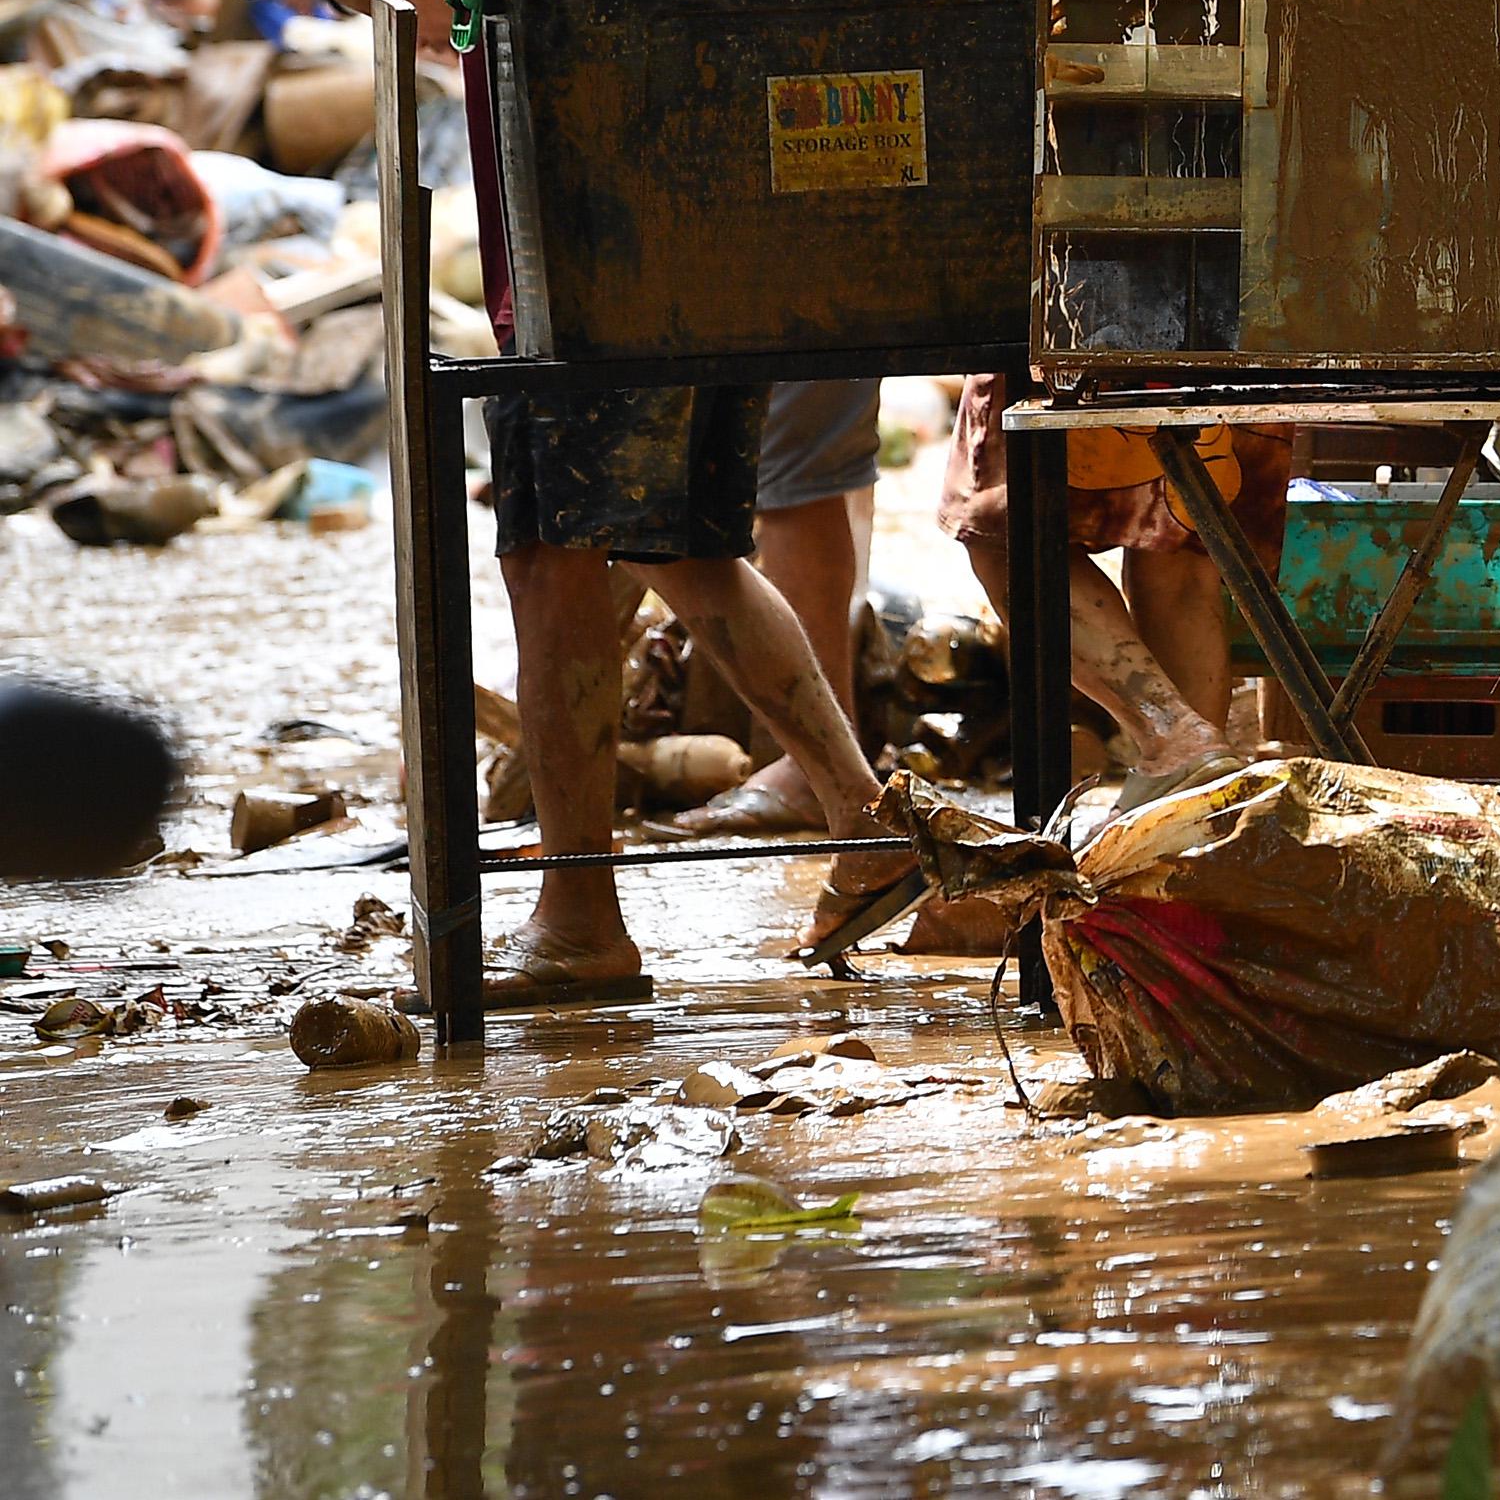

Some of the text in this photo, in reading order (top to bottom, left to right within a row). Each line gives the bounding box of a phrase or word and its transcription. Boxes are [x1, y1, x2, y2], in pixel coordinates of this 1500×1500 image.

[826, 83, 909, 127] BUNNY
[783, 133, 912, 154] STORAGE BOX
[901, 165, 920, 182] XL
